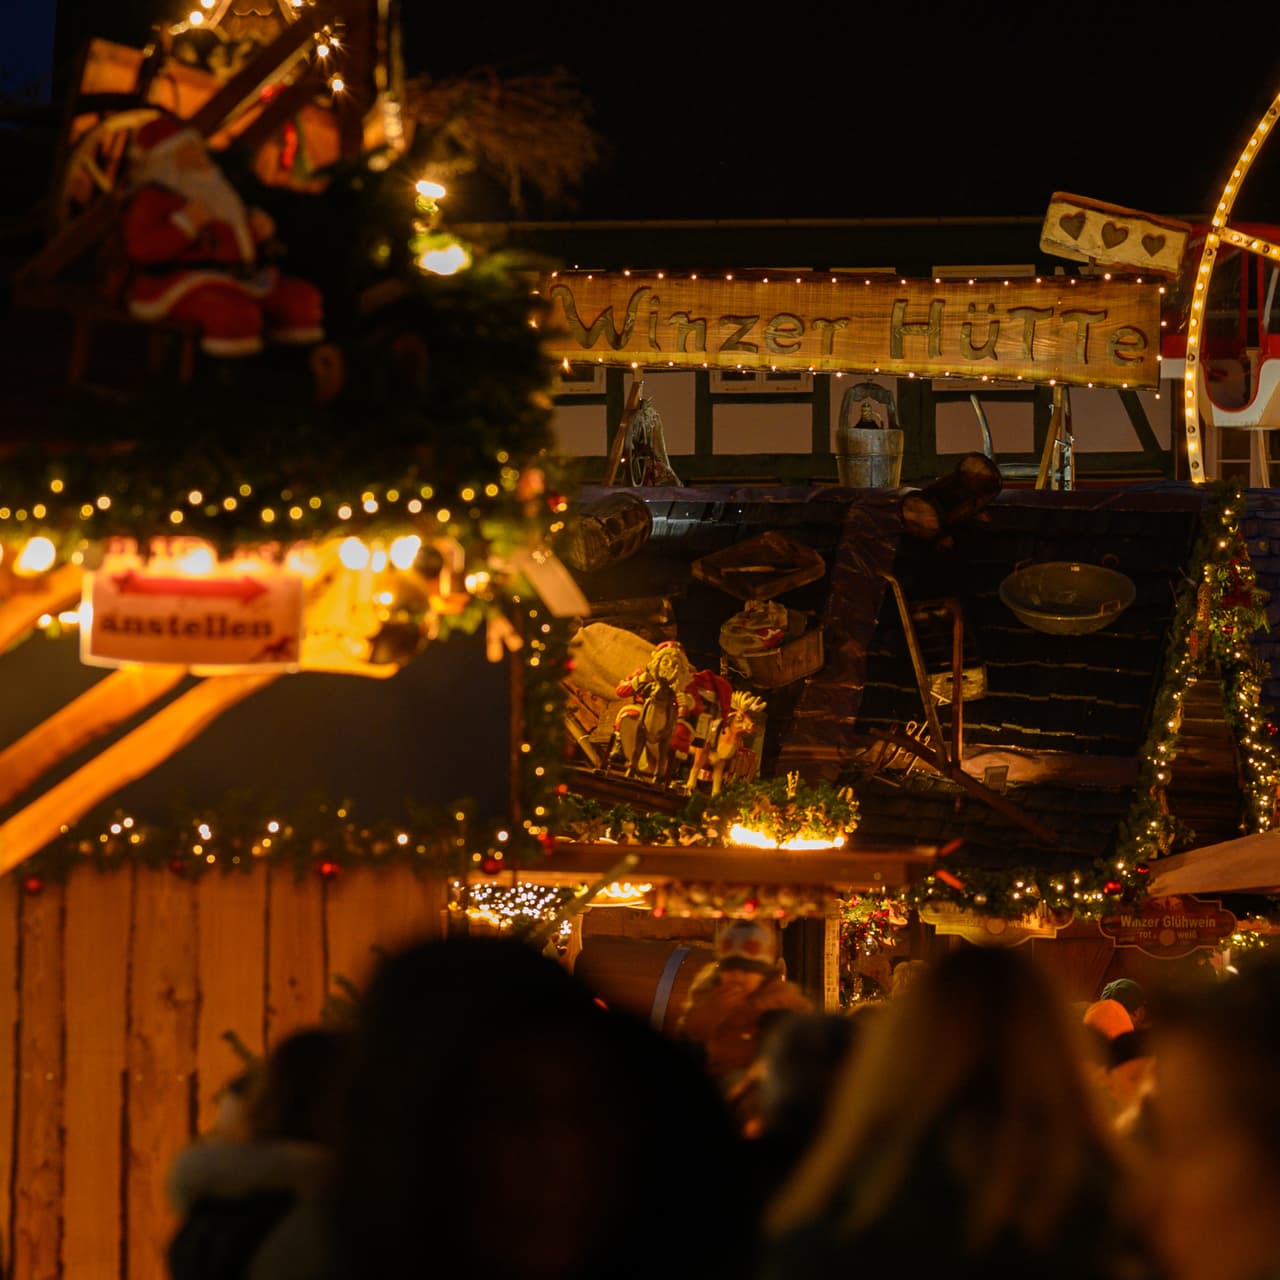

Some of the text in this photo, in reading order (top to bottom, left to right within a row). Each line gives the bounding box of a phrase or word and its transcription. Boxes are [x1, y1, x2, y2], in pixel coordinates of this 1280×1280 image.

[549, 283, 850, 354] Winzer
[1120, 913, 1216, 929] Winzer Glühwein
